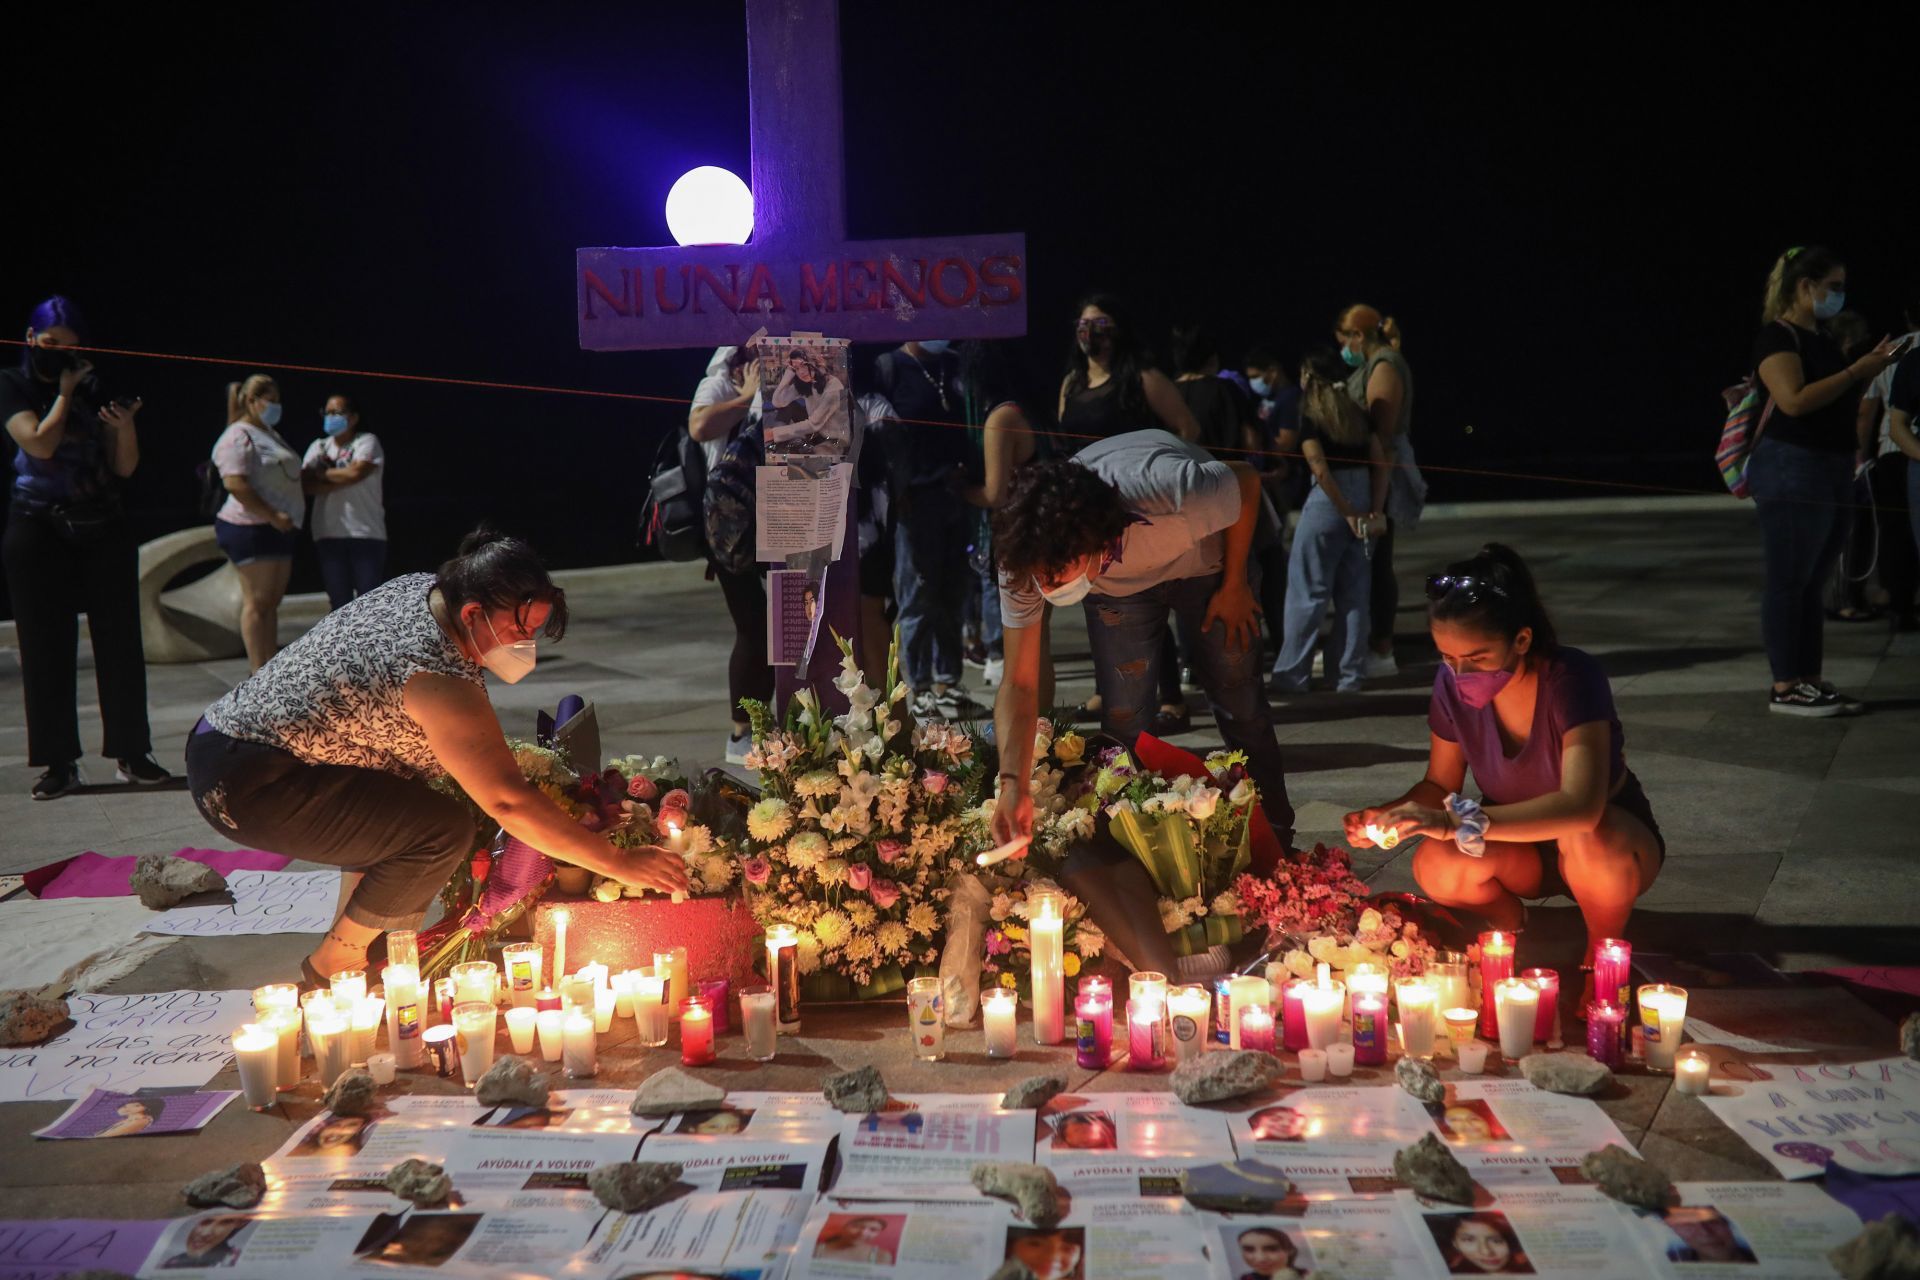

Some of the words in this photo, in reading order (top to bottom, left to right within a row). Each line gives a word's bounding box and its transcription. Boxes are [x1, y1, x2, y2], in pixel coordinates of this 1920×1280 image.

[584, 266, 644, 320] NI
[654, 262, 787, 317] UNA
[799, 254, 1023, 314] MENOS
[213, 902, 293, 917] NO
[87, 1031, 150, 1050] las
[64, 1055, 119, 1069] no
[535, 1160, 544, 1169] A
[727, 1155, 736, 1165] A
[1344, 1167, 1354, 1175] A
